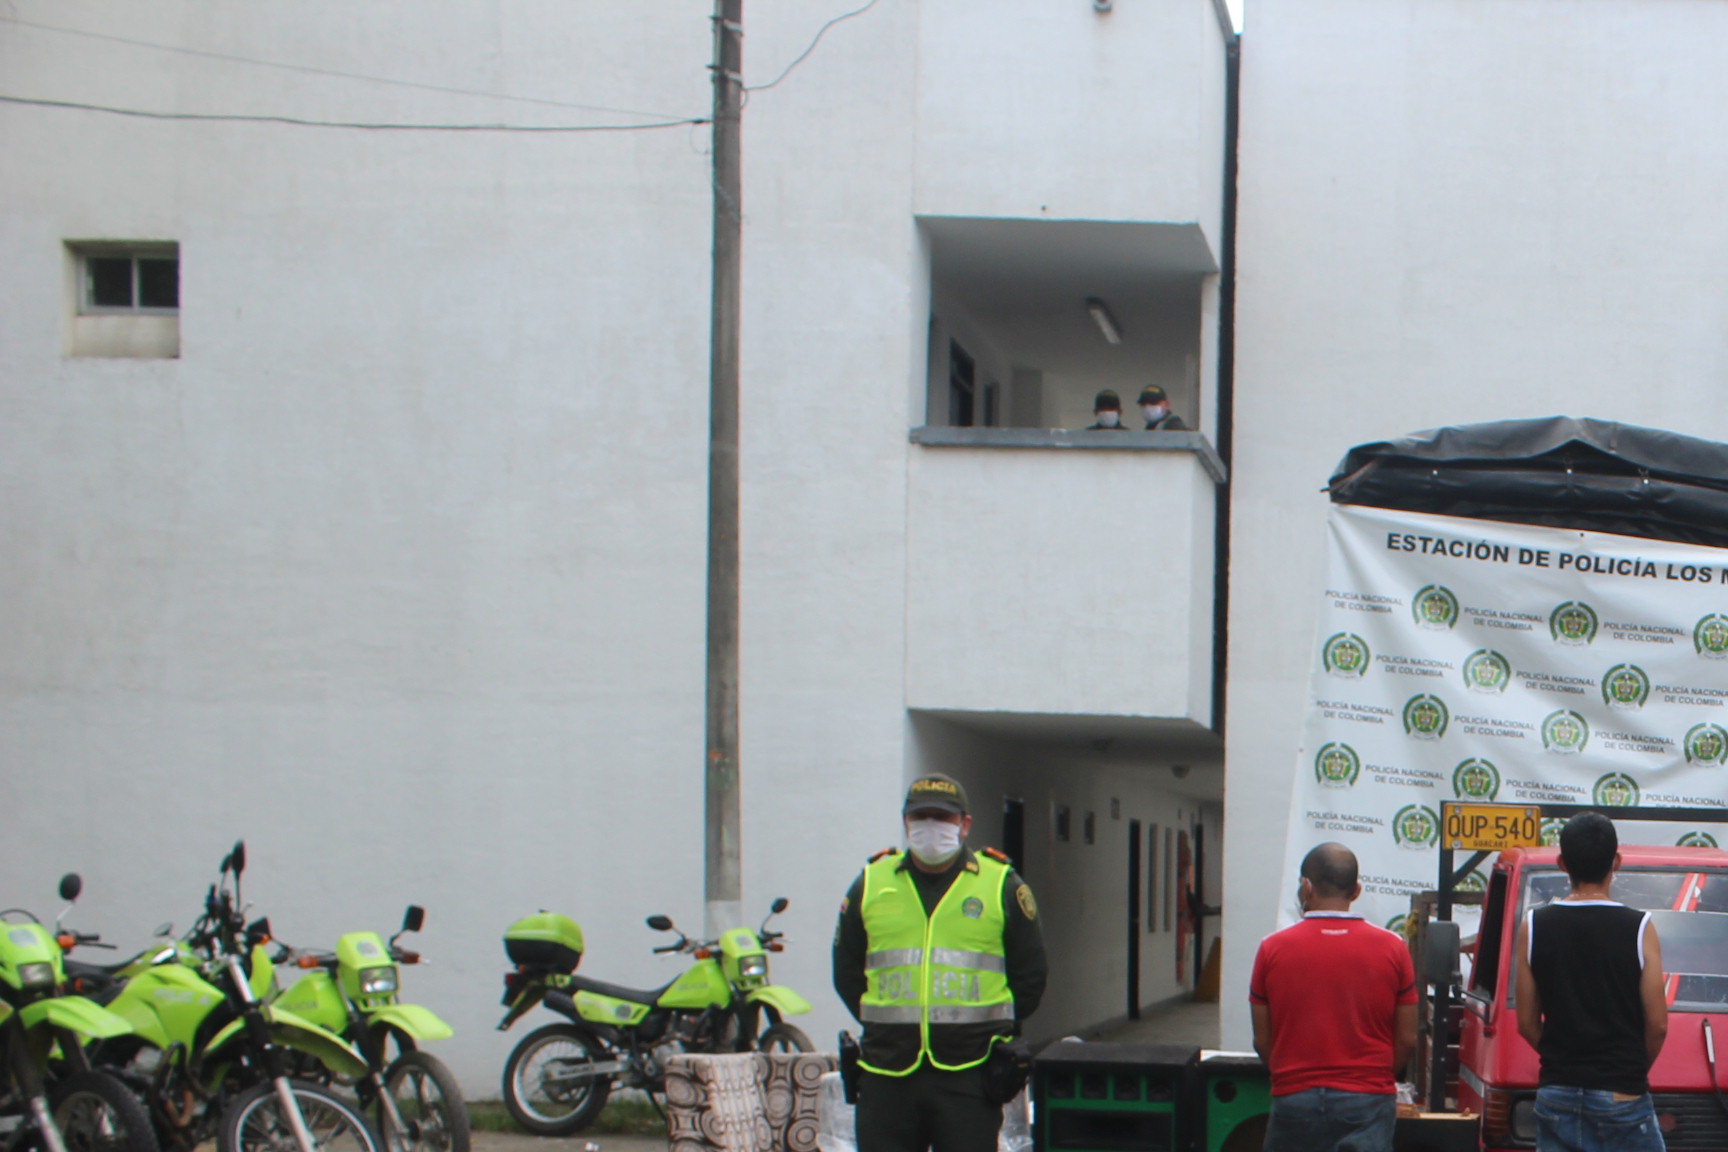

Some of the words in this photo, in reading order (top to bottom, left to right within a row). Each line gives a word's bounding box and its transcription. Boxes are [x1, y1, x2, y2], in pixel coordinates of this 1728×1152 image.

[1386, 532, 1509, 563] ESTACIÓN
[1518, 547, 1550, 568] DE
[1558, 552, 1658, 578] POLICÍA
[1665, 563, 1713, 583] LOS
[1640, 625, 1686, 636] NACIONAL
[1612, 632, 1625, 640] DE
[1627, 632, 1674, 644] COLOMBIA
[1551, 675, 1596, 686] NACIONAL
[1525, 680, 1538, 690] DE
[1540, 682, 1586, 695] COLOMBIA
[1664, 694, 1676, 704] DE
[1678, 696, 1724, 706] COLOMBIA
[1490, 718, 1536, 730] NACIONAL
[1464, 726, 1476, 734] DE
[1478, 727, 1525, 739] COLOMBIA
[1604, 741, 1616, 750] DE
[1401, 768, 1444, 780] NACIONAL
[1374, 775, 1386, 784] DE
[1388, 776, 1434, 788] COLOMBIA
[1542, 783, 1587, 794] NACIONAL
[1515, 790, 1528, 798] DE
[1528, 792, 1576, 802] COLOMBIA
[1314, 822, 1326, 830] DE
[1494, 816, 1535, 840] 540
[1364, 884, 1378, 893] DE
